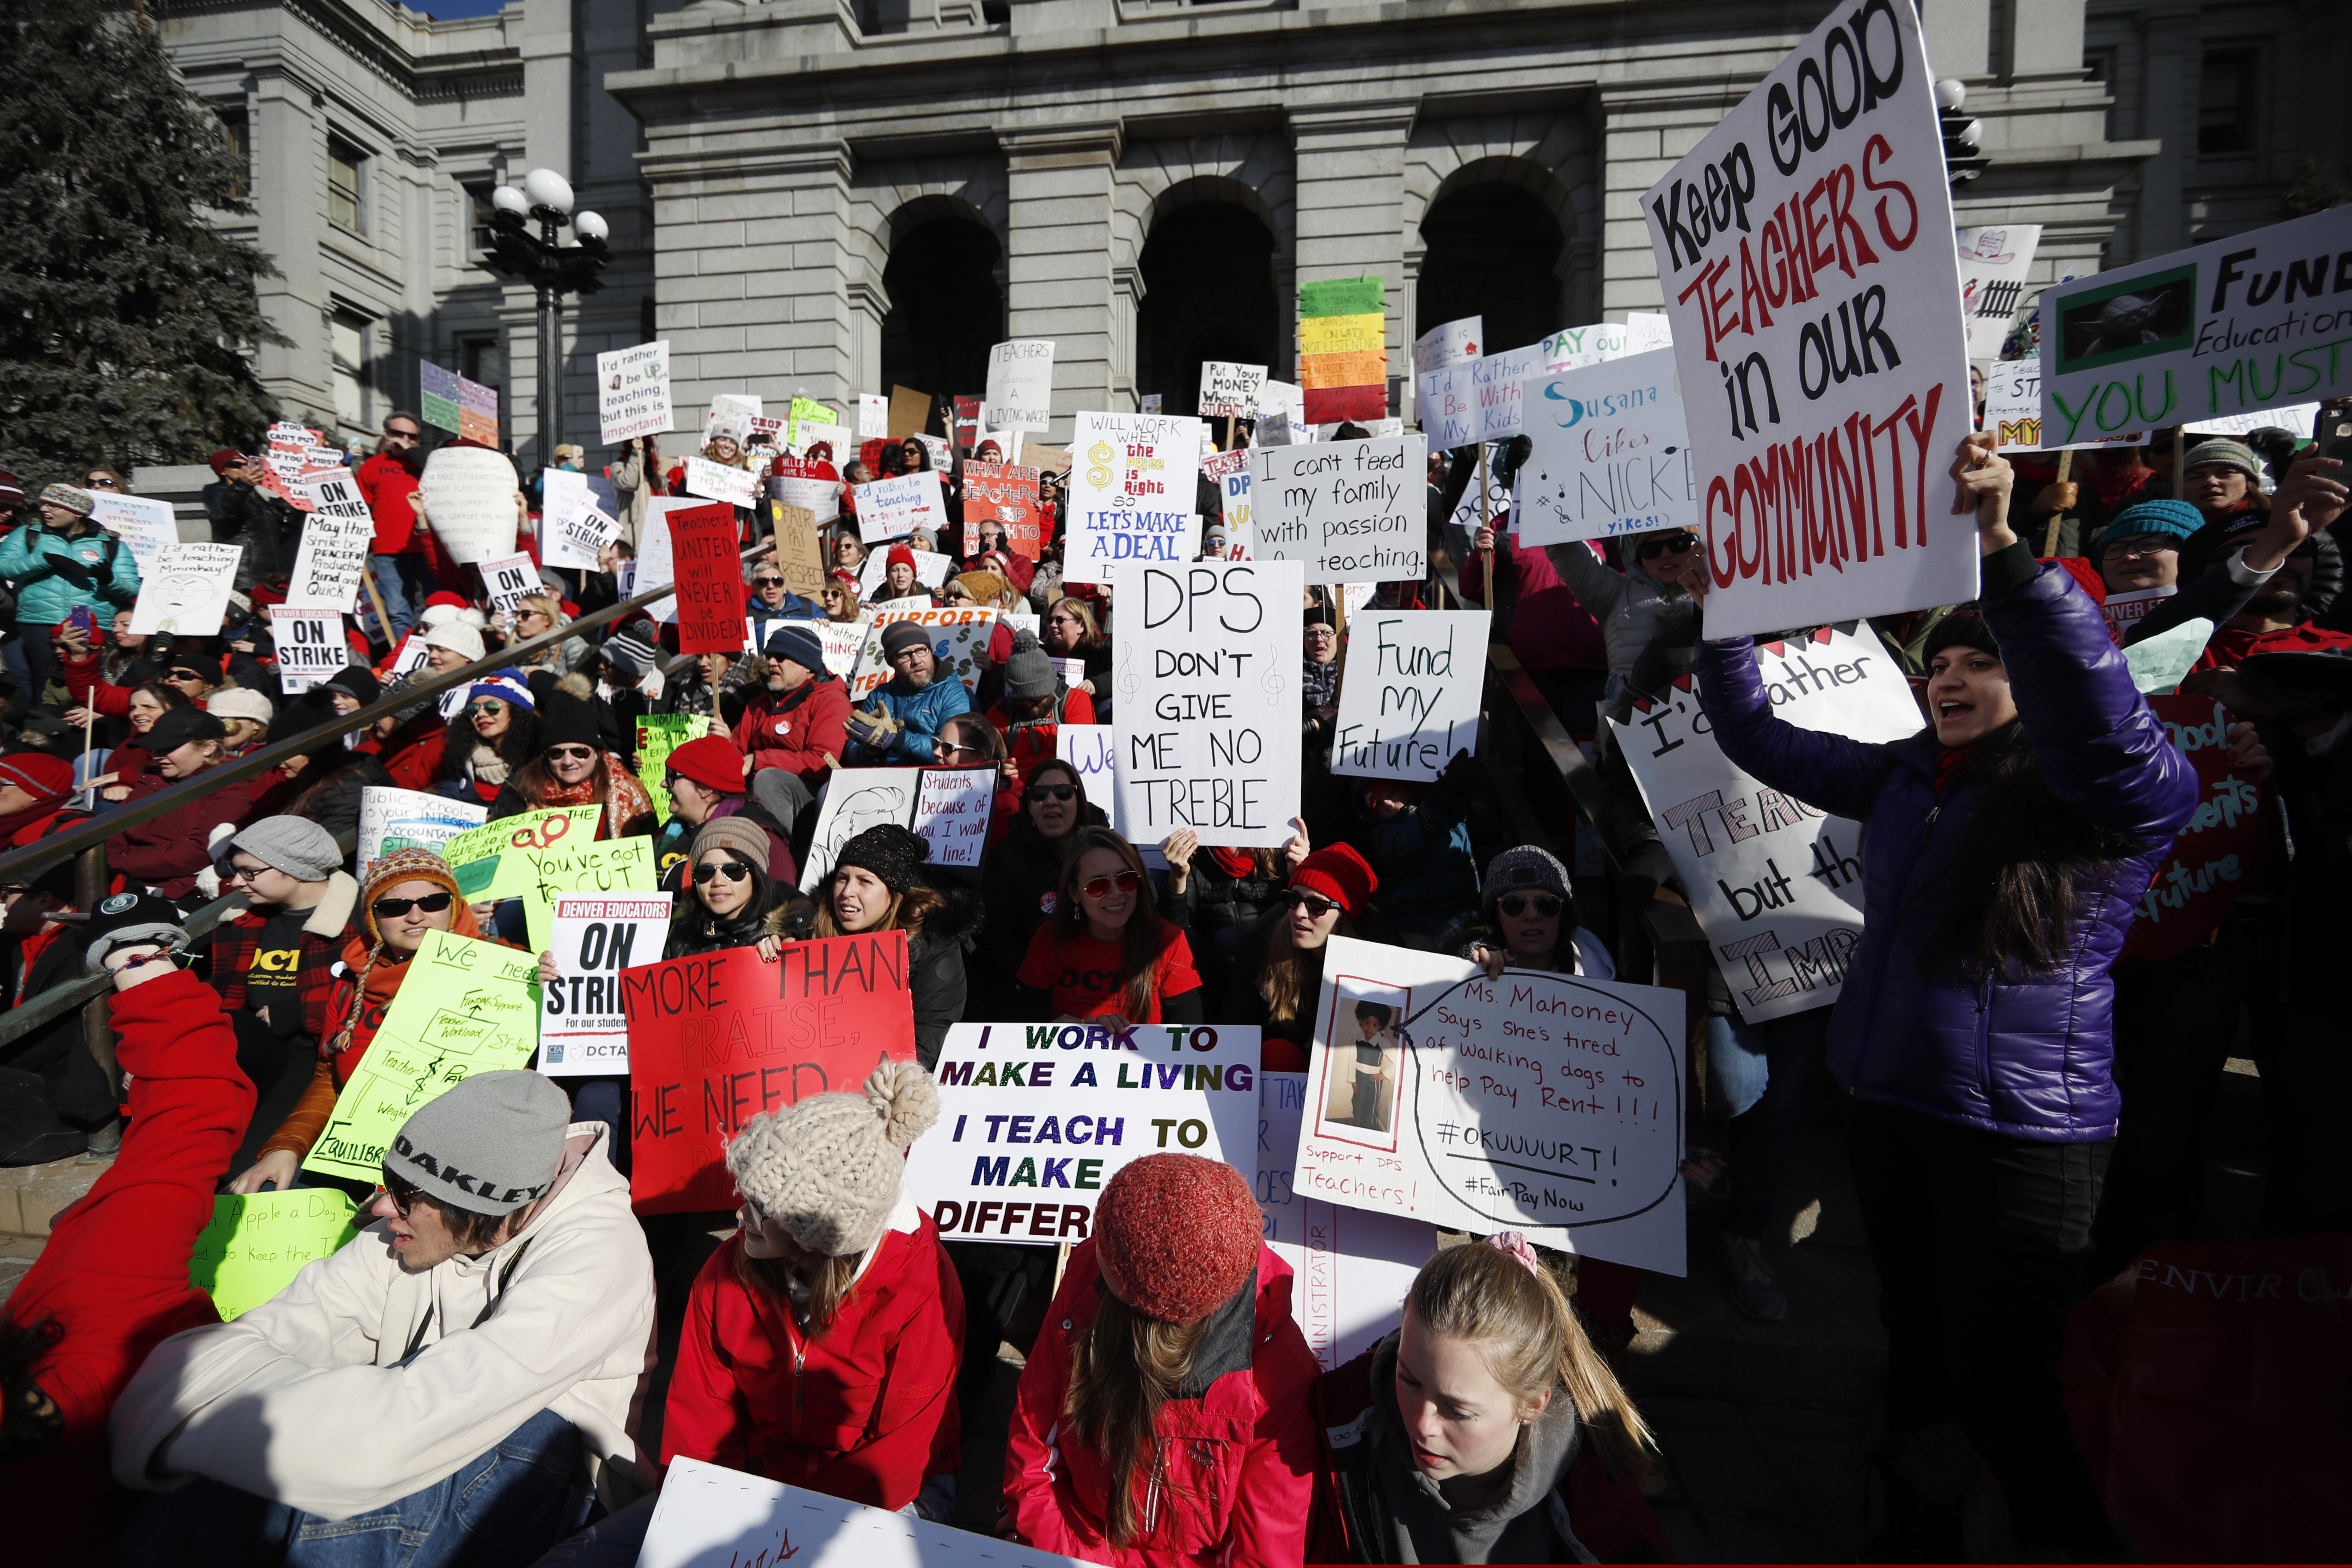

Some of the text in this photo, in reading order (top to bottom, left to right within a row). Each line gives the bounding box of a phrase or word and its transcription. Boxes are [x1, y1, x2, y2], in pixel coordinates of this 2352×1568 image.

[1653, 0, 1904, 273] Keep GOOD
[1678, 134, 1918, 362] TEACHERS
[1339, 328, 1364, 338] WATCH
[2193, 311, 2352, 358] Education
[994, 343, 1049, 363] TEACHERS
[1302, 338, 1378, 353] NOT LISTENING
[603, 349, 658, 372] I'd rather
[1323, 362, 1359, 374] PRIORITY
[1721, 285, 1902, 441] in OUR
[627, 374, 640, 384] be
[1210, 364, 1261, 379] Put Your
[1325, 373, 1381, 386] BEING FAIR
[1430, 357, 1530, 396] I'd Rather
[606, 386, 665, 406] teaching,
[1010, 388, 1019, 400] A
[1213, 379, 1260, 392] MONEY
[1203, 391, 1238, 404] Where
[1444, 381, 1521, 416] Be With
[1544, 382, 1657, 428] Susana
[2051, 369, 2178, 444] YOU
[601, 401, 664, 423] but this is
[990, 408, 1023, 424] LIVING
[1200, 403, 1244, 418] STUDENTS
[751, 417, 782, 429] CHOP
[801, 424, 816, 433] HEY
[1090, 415, 1182, 437] WILL WORK
[1444, 406, 1520, 444] My Kids
[1116, 432, 1160, 444] WHEN
[1584, 428, 1651, 462] likes
[1127, 443, 1154, 458] the
[1294, 444, 1404, 477] can't feed
[782, 458, 805, 468] HELLO
[964, 460, 1040, 481] WHAT ARE
[1126, 469, 1138, 480] is
[320, 481, 348, 502] ON
[878, 481, 904, 494] rather
[1706, 383, 1943, 589] COMMUNITY
[1113, 496, 1136, 506] SO
[1284, 478, 1401, 517] my family
[106, 516, 152, 525] STUDENTS
[119, 524, 144, 532] FIRST
[308, 518, 369, 537] May this
[584, 514, 608, 533] ON
[672, 514, 728, 531] Teachers
[782, 505, 812, 530] FAIR
[861, 511, 894, 525] but this
[1086, 509, 1188, 533] LET'S MAKE
[1598, 513, 1669, 535] (yikes!)
[306, 535, 340, 547] Strike
[788, 526, 805, 548] PAY
[1261, 514, 1407, 547] with passion
[160, 544, 239, 553] I'd rather
[675, 537, 731, 560] UNITED
[1090, 533, 1179, 562] A DEAL
[157, 554, 236, 567] be teaching
[314, 559, 363, 572] Productive
[688, 563, 712, 578] will
[342, 577, 358, 585] and
[498, 568, 526, 591] ON
[781, 561, 825, 587] RESPECT
[307, 582, 345, 599] Quick
[680, 582, 733, 603] NEVER
[1144, 567, 1263, 633] DPS
[274, 609, 340, 618] DENVER EDUCATORS
[700, 605, 714, 619] be
[873, 610, 992, 628] SUPPORT
[292, 620, 325, 644] ON
[682, 619, 742, 642] DIVIDED!
[279, 647, 345, 666] STRIKE
[1376, 619, 1454, 678] Fund
[1155, 648, 1253, 679] DON'T
[1155, 694, 1233, 722] GIVE
[1380, 686, 1443, 741] my
[1131, 728, 1262, 770] ME NO
[924, 772, 973, 790] Students,
[364, 788, 407, 804] Public
[922, 794, 987, 815] because of
[1130, 778, 1268, 829] TREBLE
[379, 808, 413, 824] your
[567, 809, 595, 819] THE
[942, 818, 987, 837] I walk
[943, 842, 973, 862] line!
[1717, 859, 1795, 921] but
[562, 902, 667, 918] DENVER EDUCATORS
[437, 934, 477, 966] We
[580, 922, 637, 971] ON
[625, 934, 902, 1022] MORE THAN
[1509, 984, 1634, 1033] Mahoney
[437, 1014, 468, 1026] Teacher
[566, 1018, 594, 1028] For our
[441, 1026, 484, 1038] Workload
[977, 1025, 1219, 1052] I TO
[586, 1046, 627, 1056] DCTA
[1563, 1031, 1620, 1058] tired
[1426, 1036, 1645, 1090] of dogs to
[939, 1061, 1253, 1092] MAKE A LIVING
[1432, 1063, 1471, 1093] help
[377, 1101, 407, 1122] Weight
[634, 1083, 683, 1141] WE
[952, 1114, 1209, 1149] I TEACH TO
[1306, 1145, 1402, 1171] Support DPS
[970, 1156, 1104, 1190] MAKE
[229, 1195, 336, 1232] Apple a Day
[222, 1244, 311, 1263] to Keep the
[2111, 1259, 2282, 1302] DENVER
